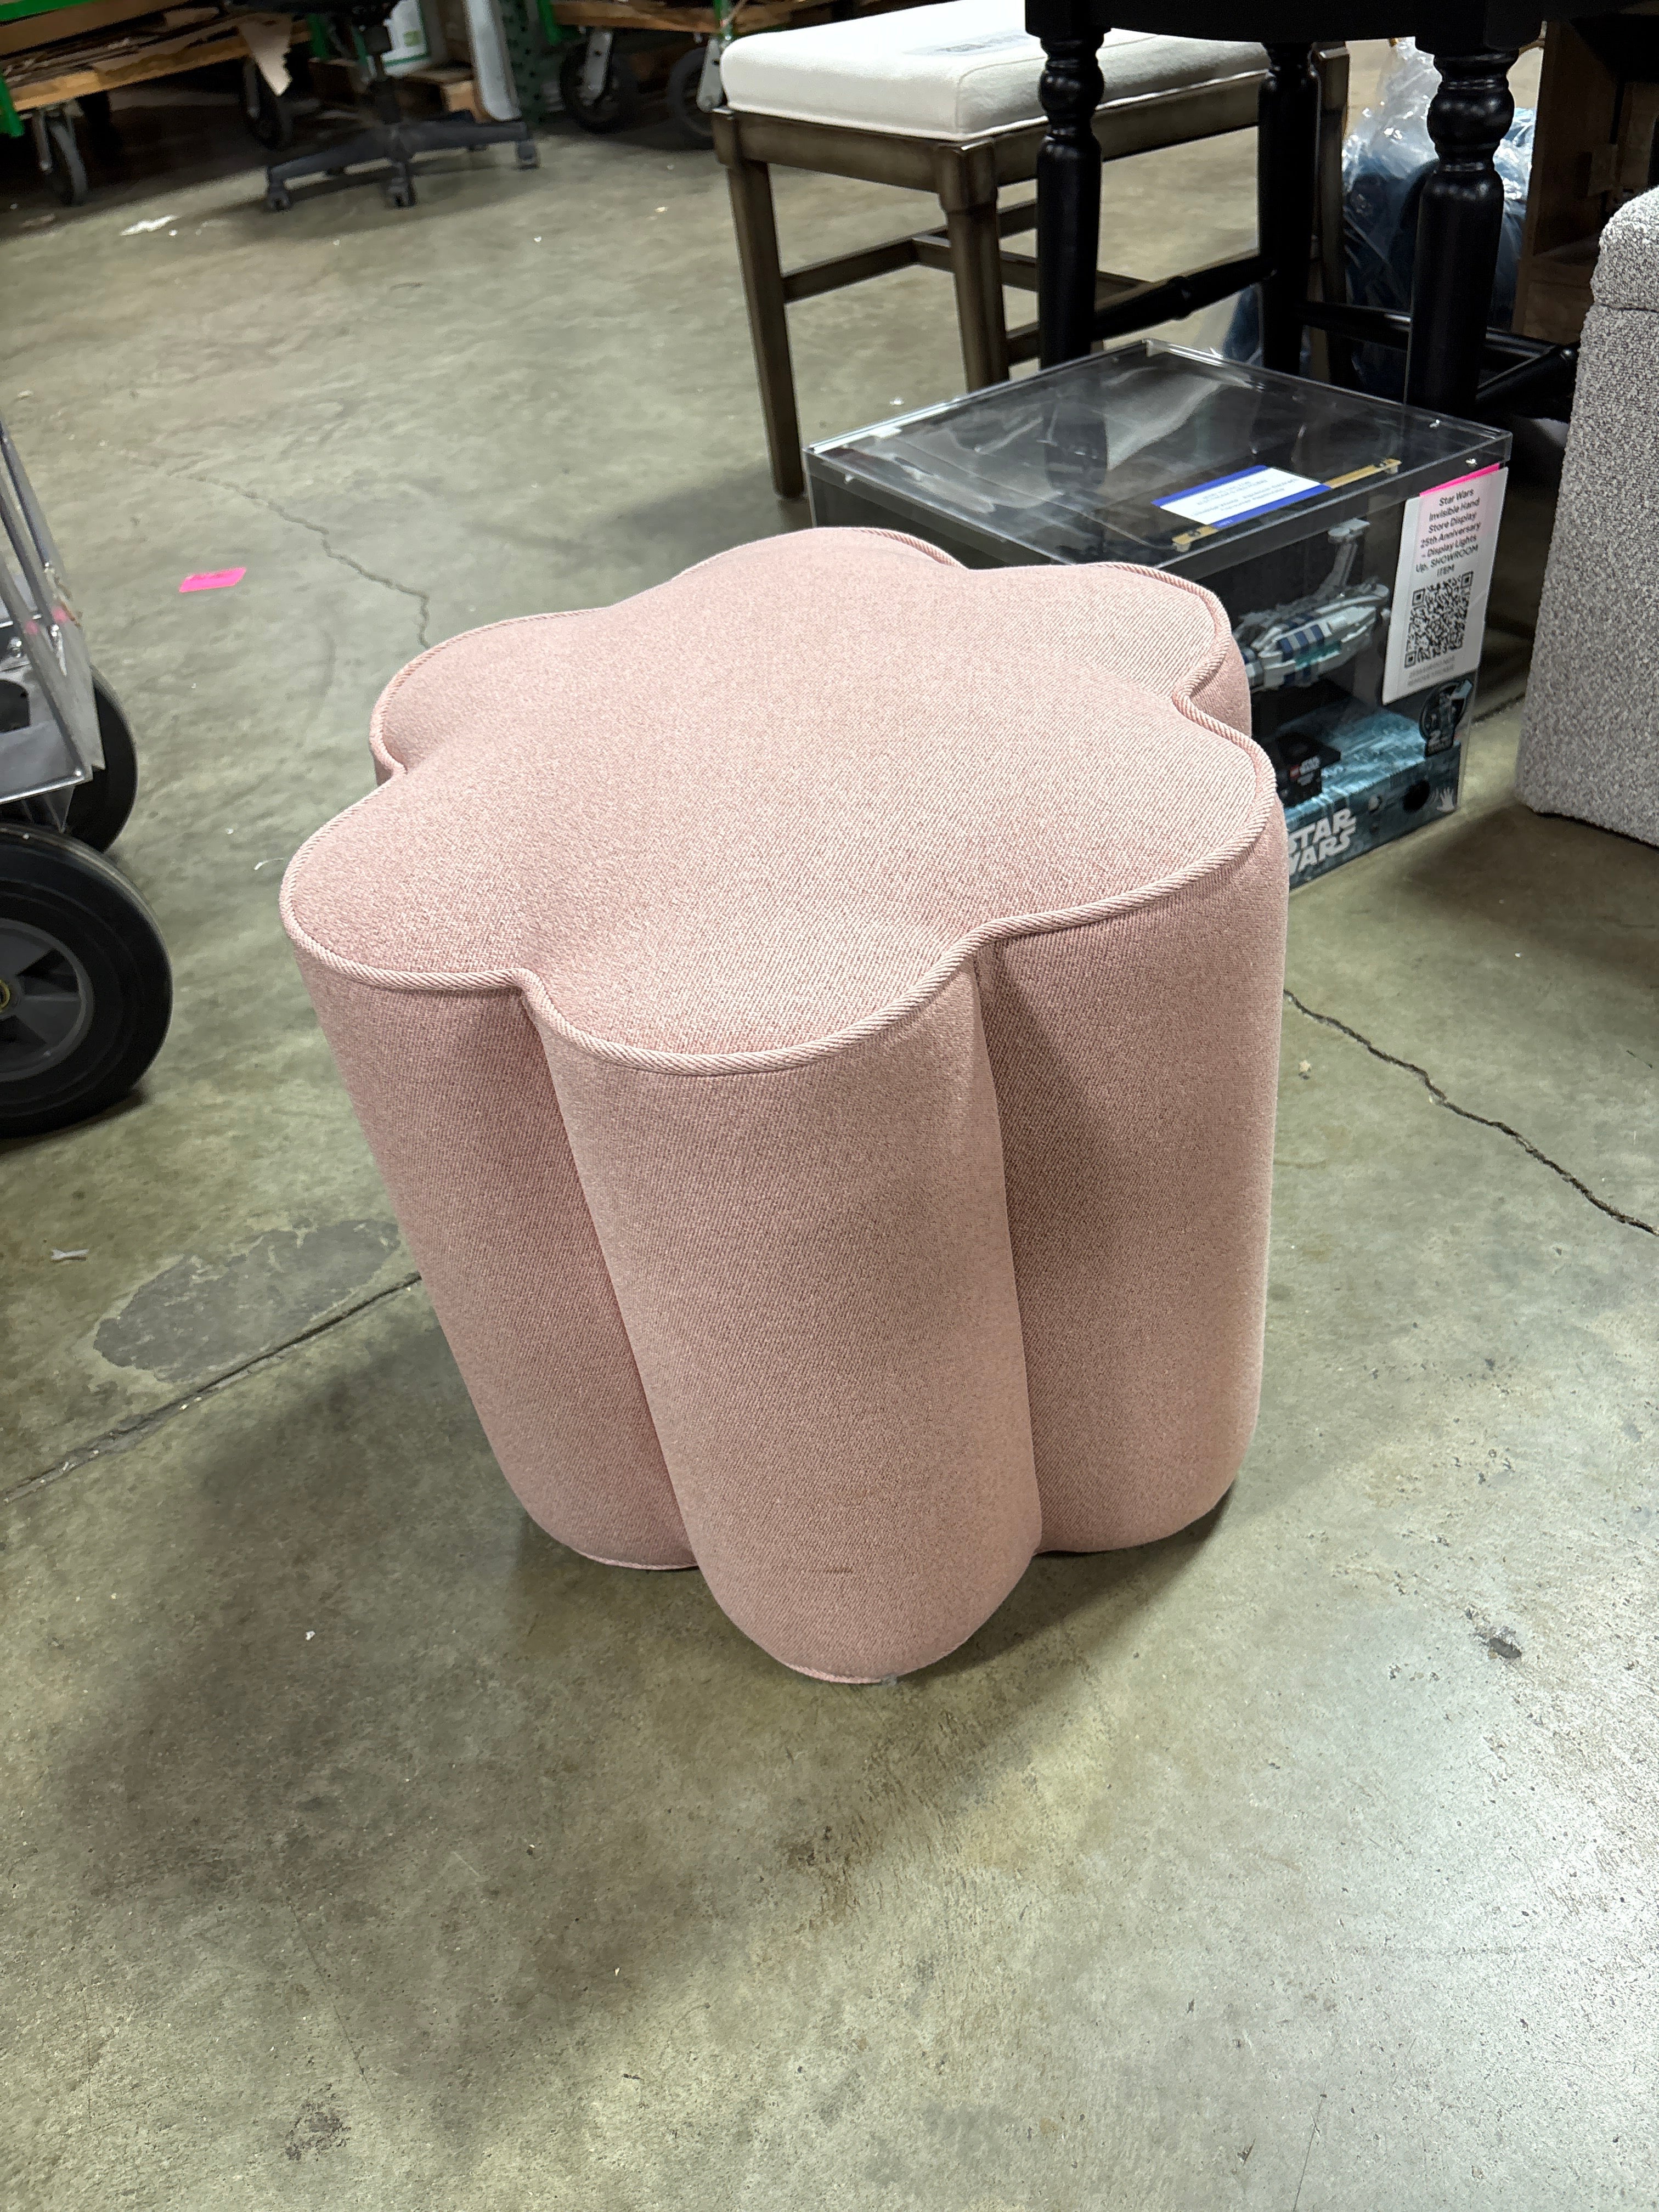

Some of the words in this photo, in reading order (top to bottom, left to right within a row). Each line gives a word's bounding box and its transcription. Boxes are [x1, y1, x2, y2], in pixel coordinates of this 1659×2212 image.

[1439, 496, 1455, 506] Star
[1456, 489, 1474, 500] Wars
[1429, 505, 1459, 522] Invisible
[1460, 497, 1480, 511] Hand
[1429, 521, 1449, 533] Store
[1450, 511, 1477, 527] Display
[1420, 535, 1437, 548] 25th
[1438, 521, 1481, 542] Anniversary
[1427, 542, 1454, 557] Display
[1455, 534, 1477, 548] Lights
[1430, 543, 1479, 568] SHOWROOM
[1437, 563, 1455, 577] ITEM
